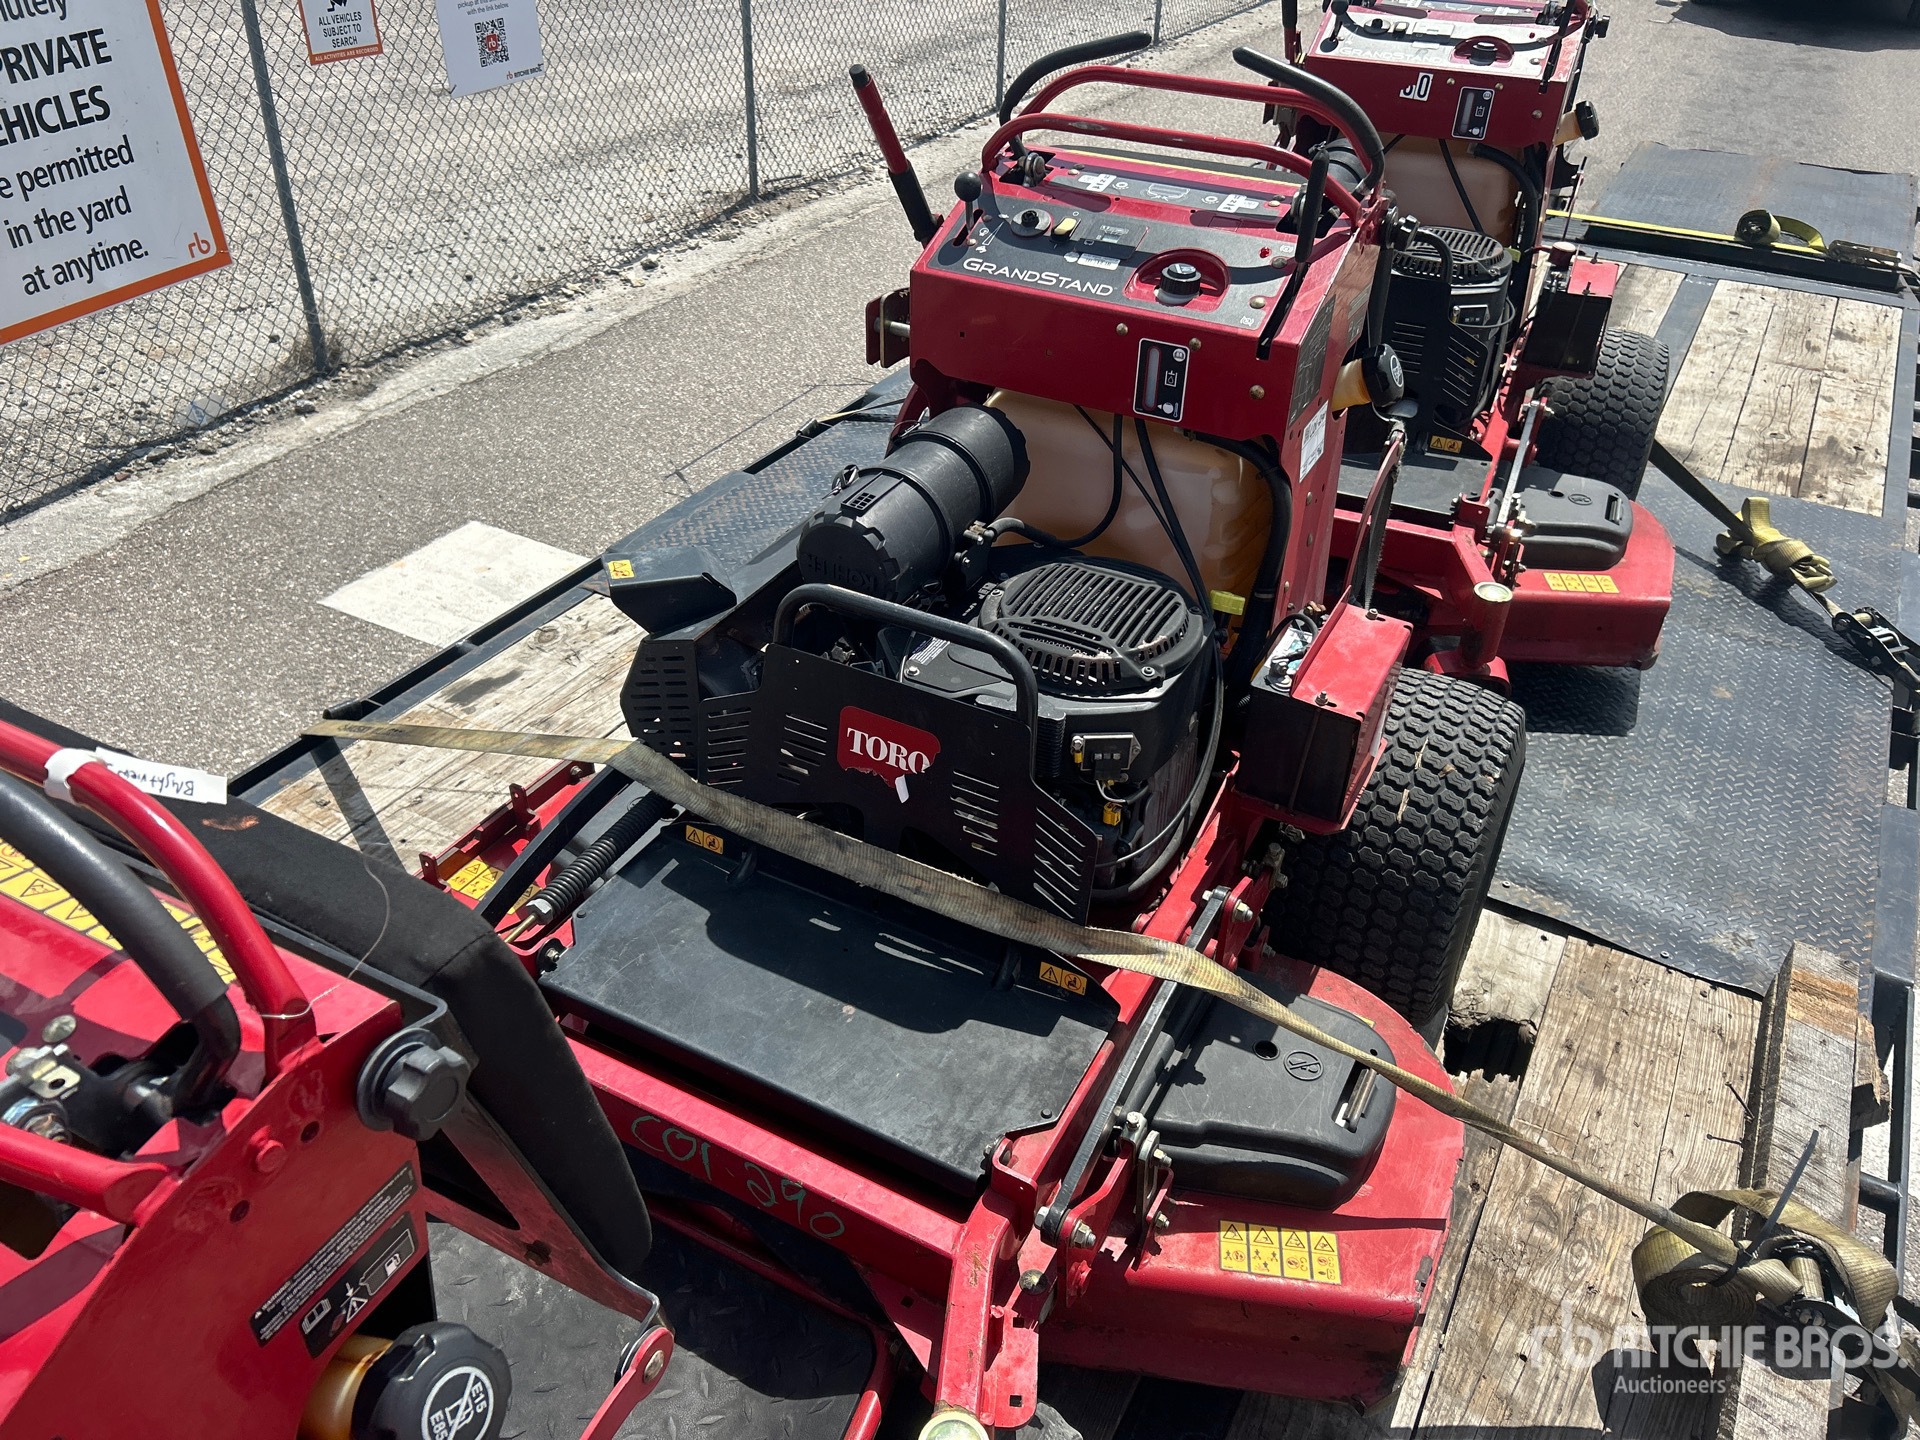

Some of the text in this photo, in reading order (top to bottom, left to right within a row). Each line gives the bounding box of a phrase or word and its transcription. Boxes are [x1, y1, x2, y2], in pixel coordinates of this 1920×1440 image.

[318, 11, 362, 26] ALL VEHICLES
[323, 23, 362, 37] SUBJECT TO
[0, 28, 112, 84] RIVATE
[323, 52, 346, 60] ACTIVITIES
[356, 46, 379, 55] RECORDED
[332, 36, 358, 48] SEARCH
[0, 85, 111, 147] HICLES
[16, 134, 135, 202] permitted
[4, 185, 132, 249] in the yard
[187, 232, 211, 258] rb
[21, 239, 149, 295] at anytime.
[846, 727, 931, 774] TORO
[471, 1381, 488, 1413] E15
[429, 1409, 449, 1440] E85
